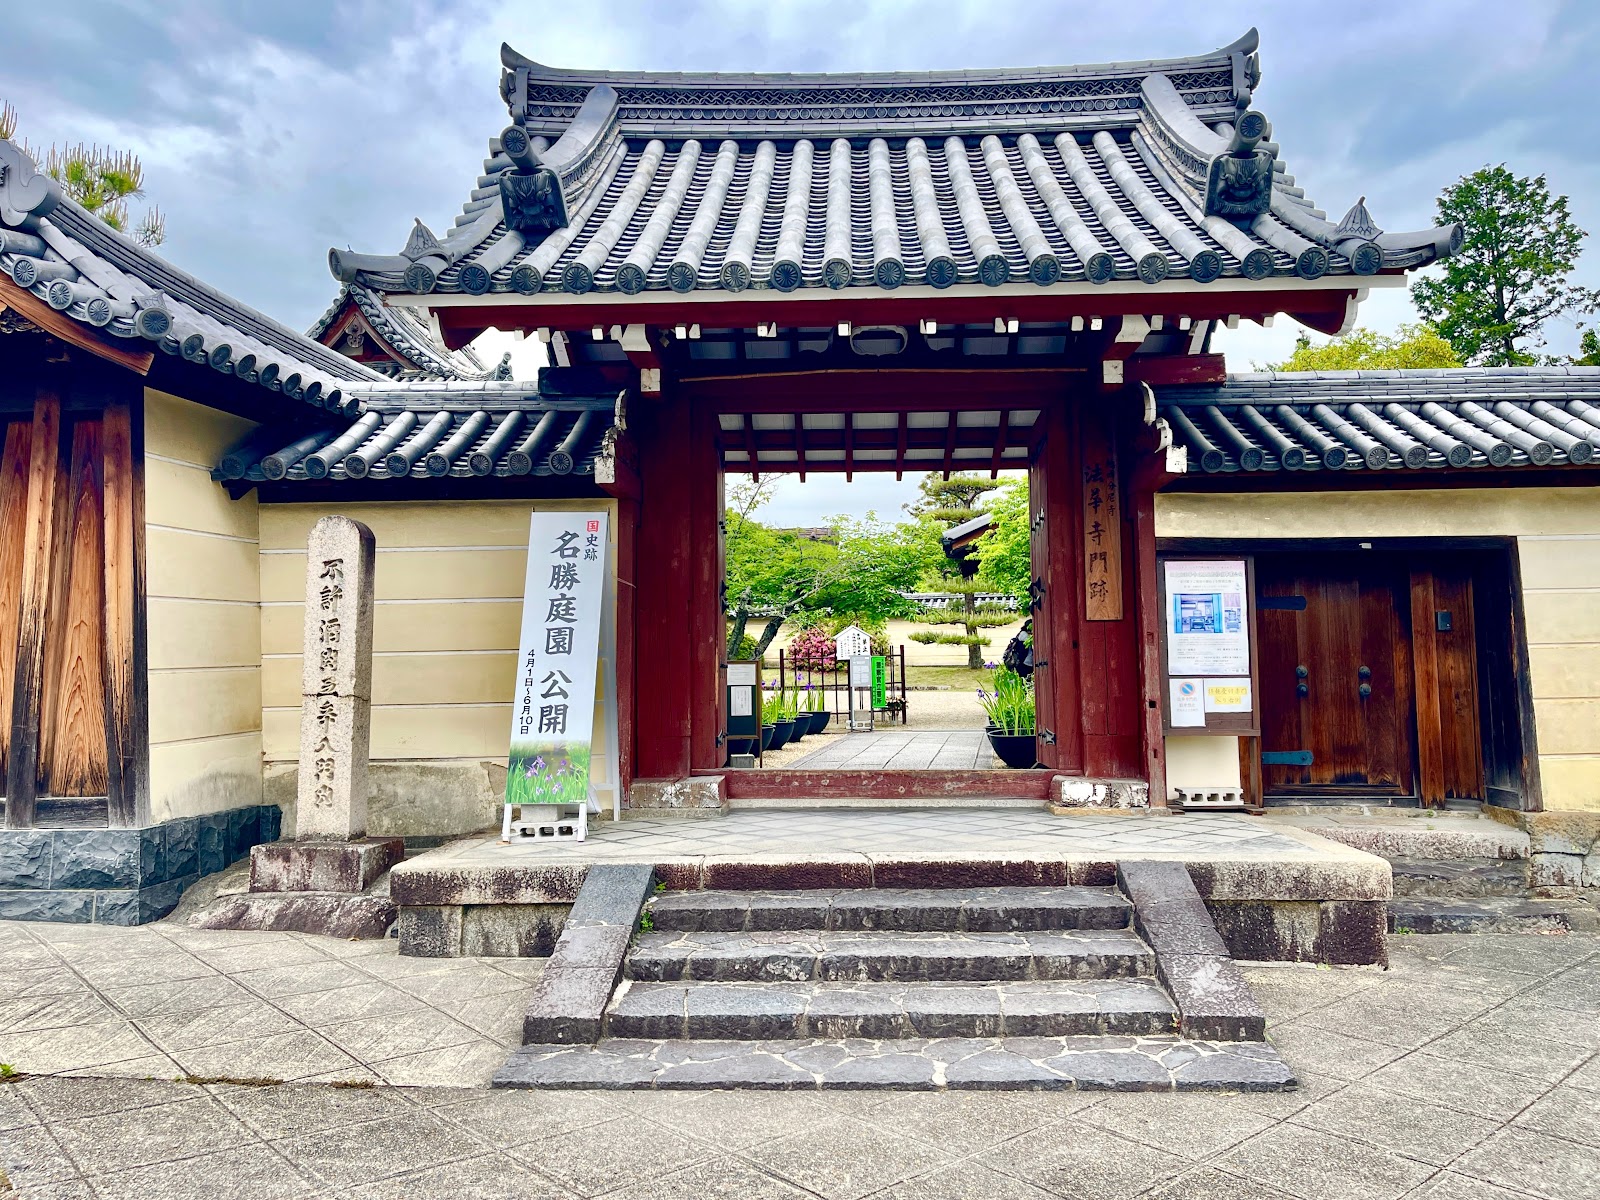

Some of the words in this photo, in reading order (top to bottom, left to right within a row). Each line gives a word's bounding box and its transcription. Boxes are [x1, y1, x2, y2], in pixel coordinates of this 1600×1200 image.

[583, 520, 600, 562] 国史跡
[544, 530, 582, 656] 名勝庭園
[537, 669, 572, 735] 公開
